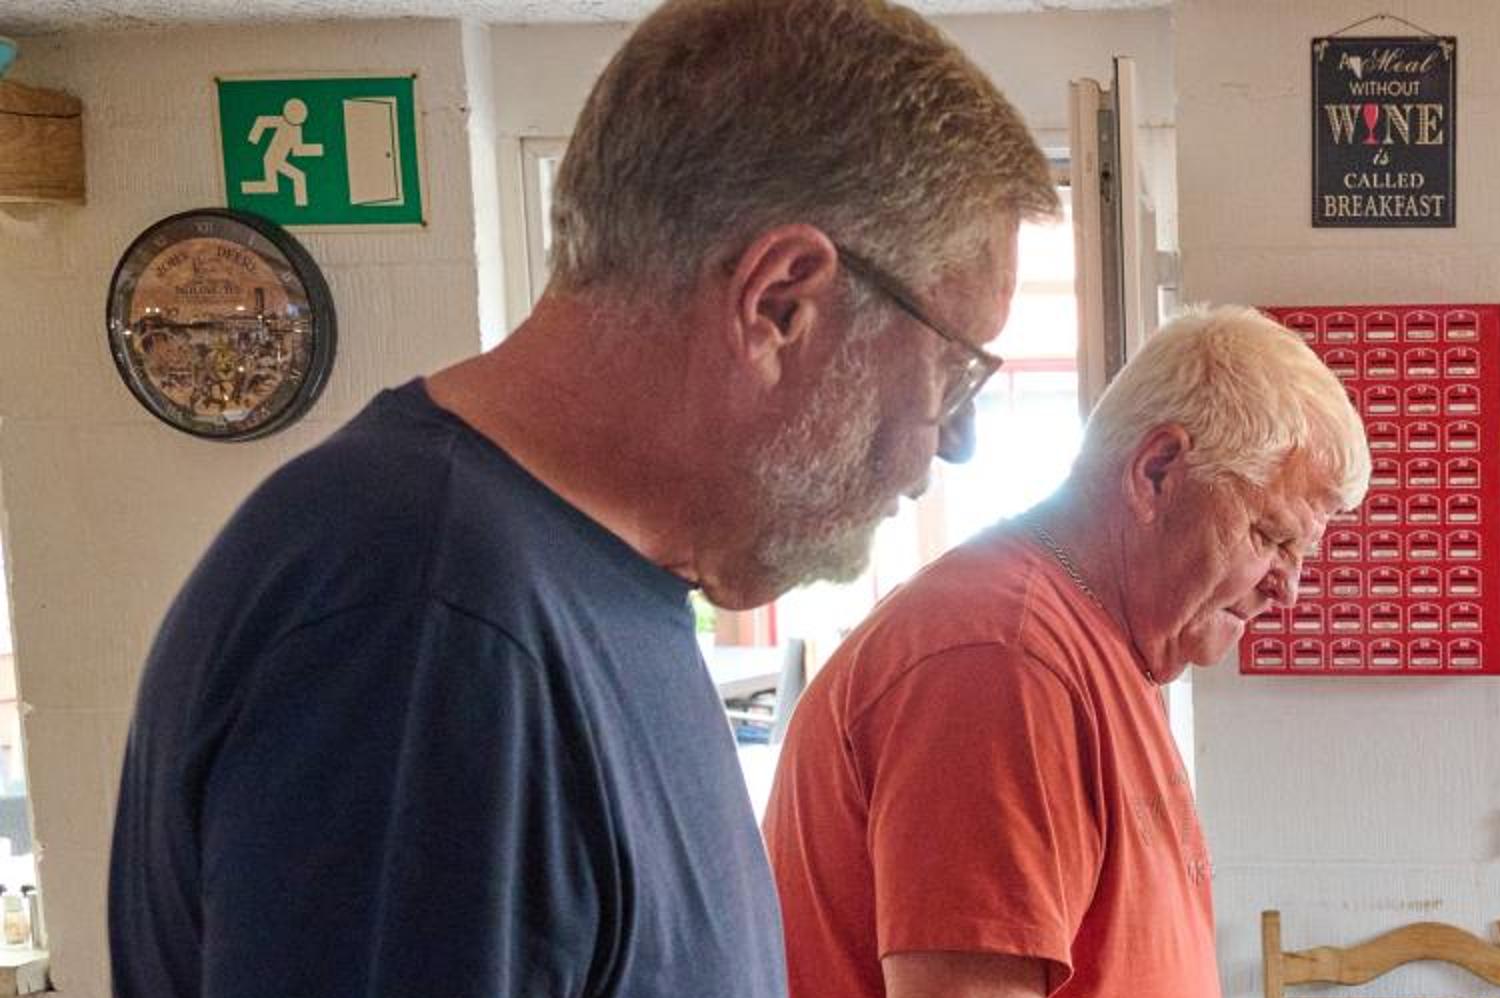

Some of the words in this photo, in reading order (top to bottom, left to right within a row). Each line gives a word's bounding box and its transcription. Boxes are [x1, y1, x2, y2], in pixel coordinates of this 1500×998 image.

[1362, 48, 1439, 73] Meal
[1349, 82, 1421, 95] WITHOUT
[1372, 148, 1390, 166] is
[1344, 173, 1425, 189] CALLED
[1324, 195, 1446, 217] BREAKFAST
